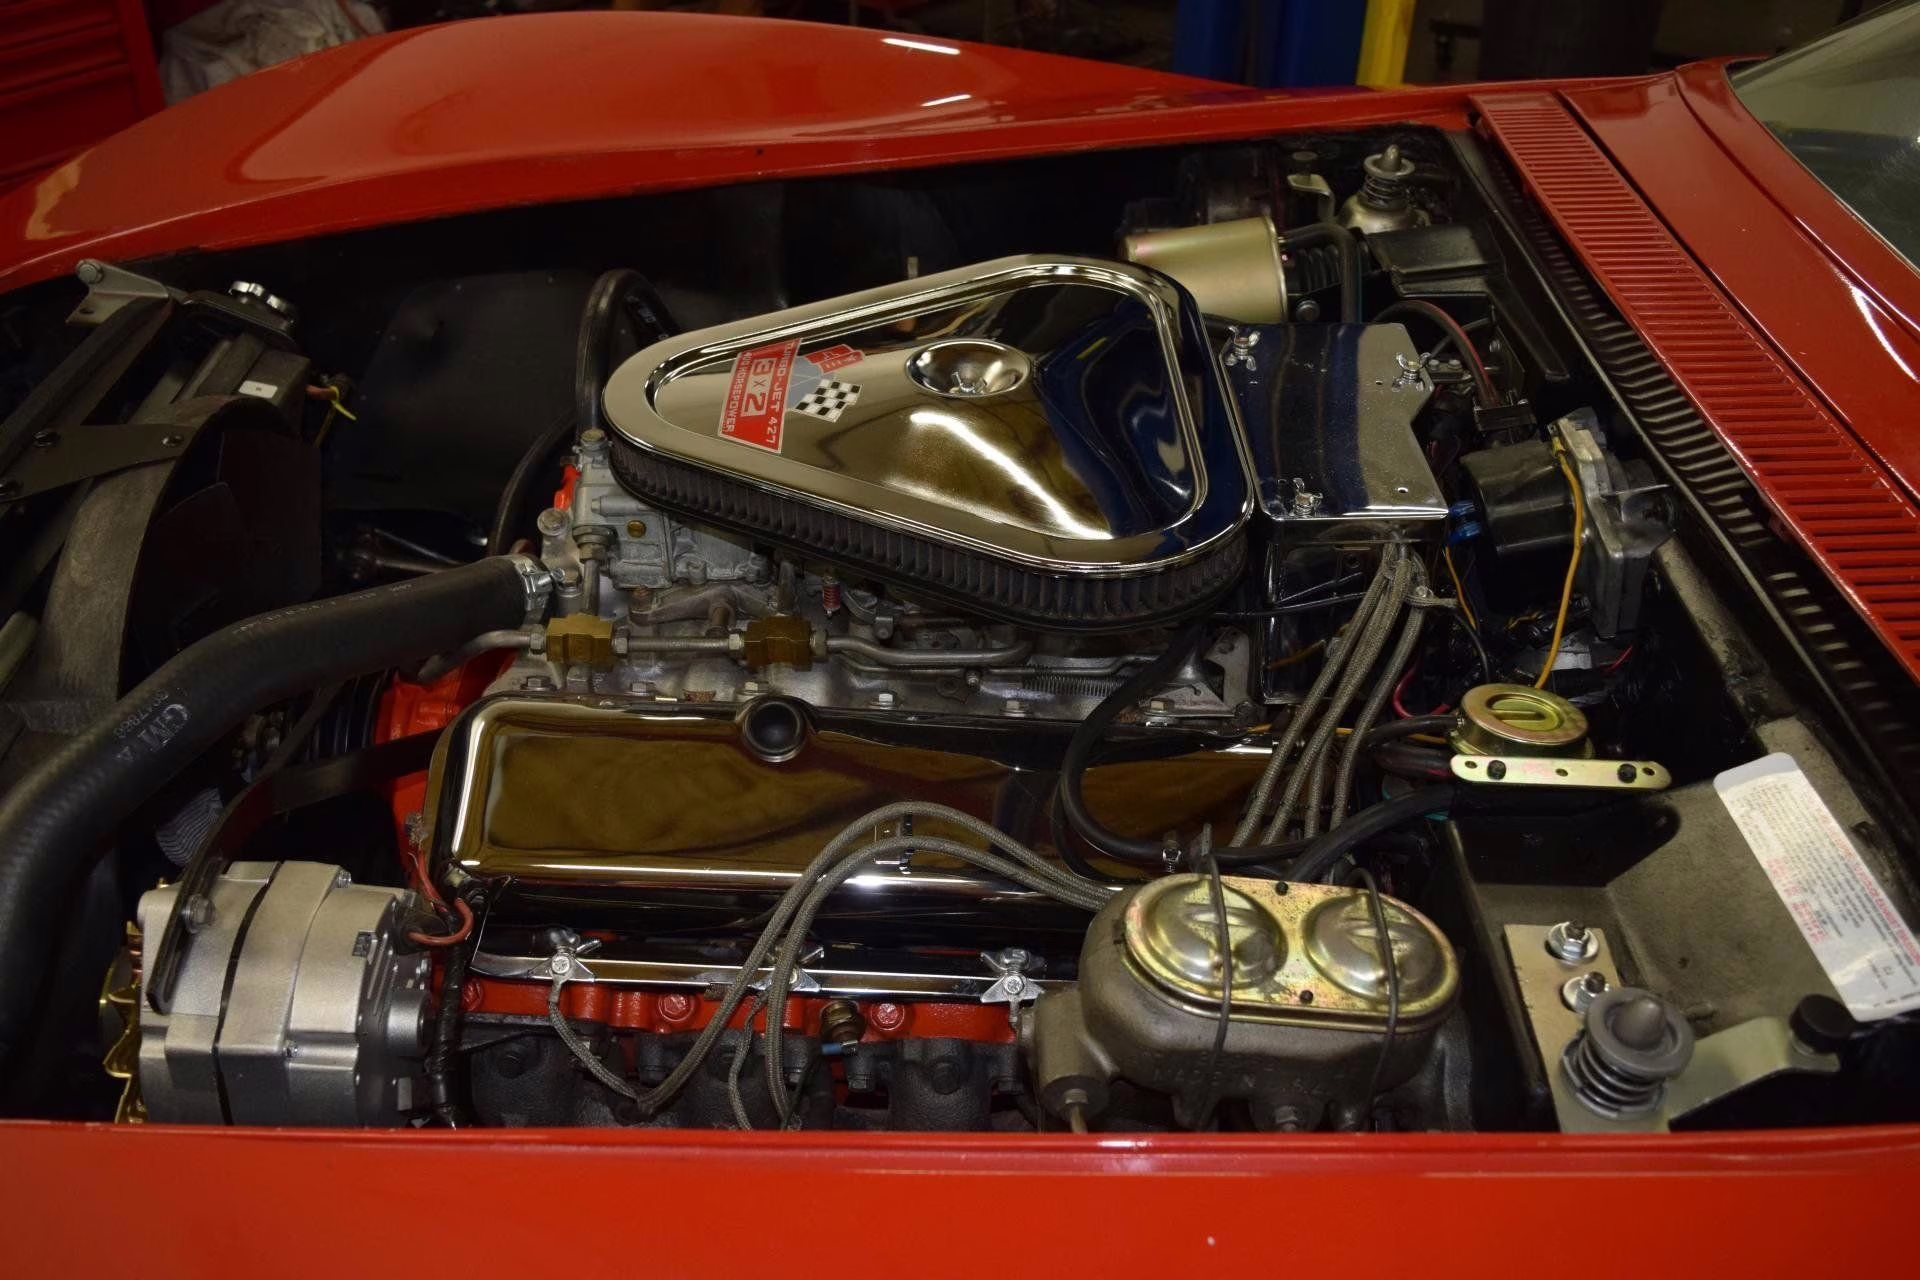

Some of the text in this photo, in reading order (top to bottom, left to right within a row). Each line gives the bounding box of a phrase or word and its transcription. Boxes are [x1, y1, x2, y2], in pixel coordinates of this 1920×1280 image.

[753, 360, 774, 375] 3
[727, 367, 748, 432] HORSEPOWER
[744, 392, 766, 413] 2
[766, 417, 778, 443] 427
